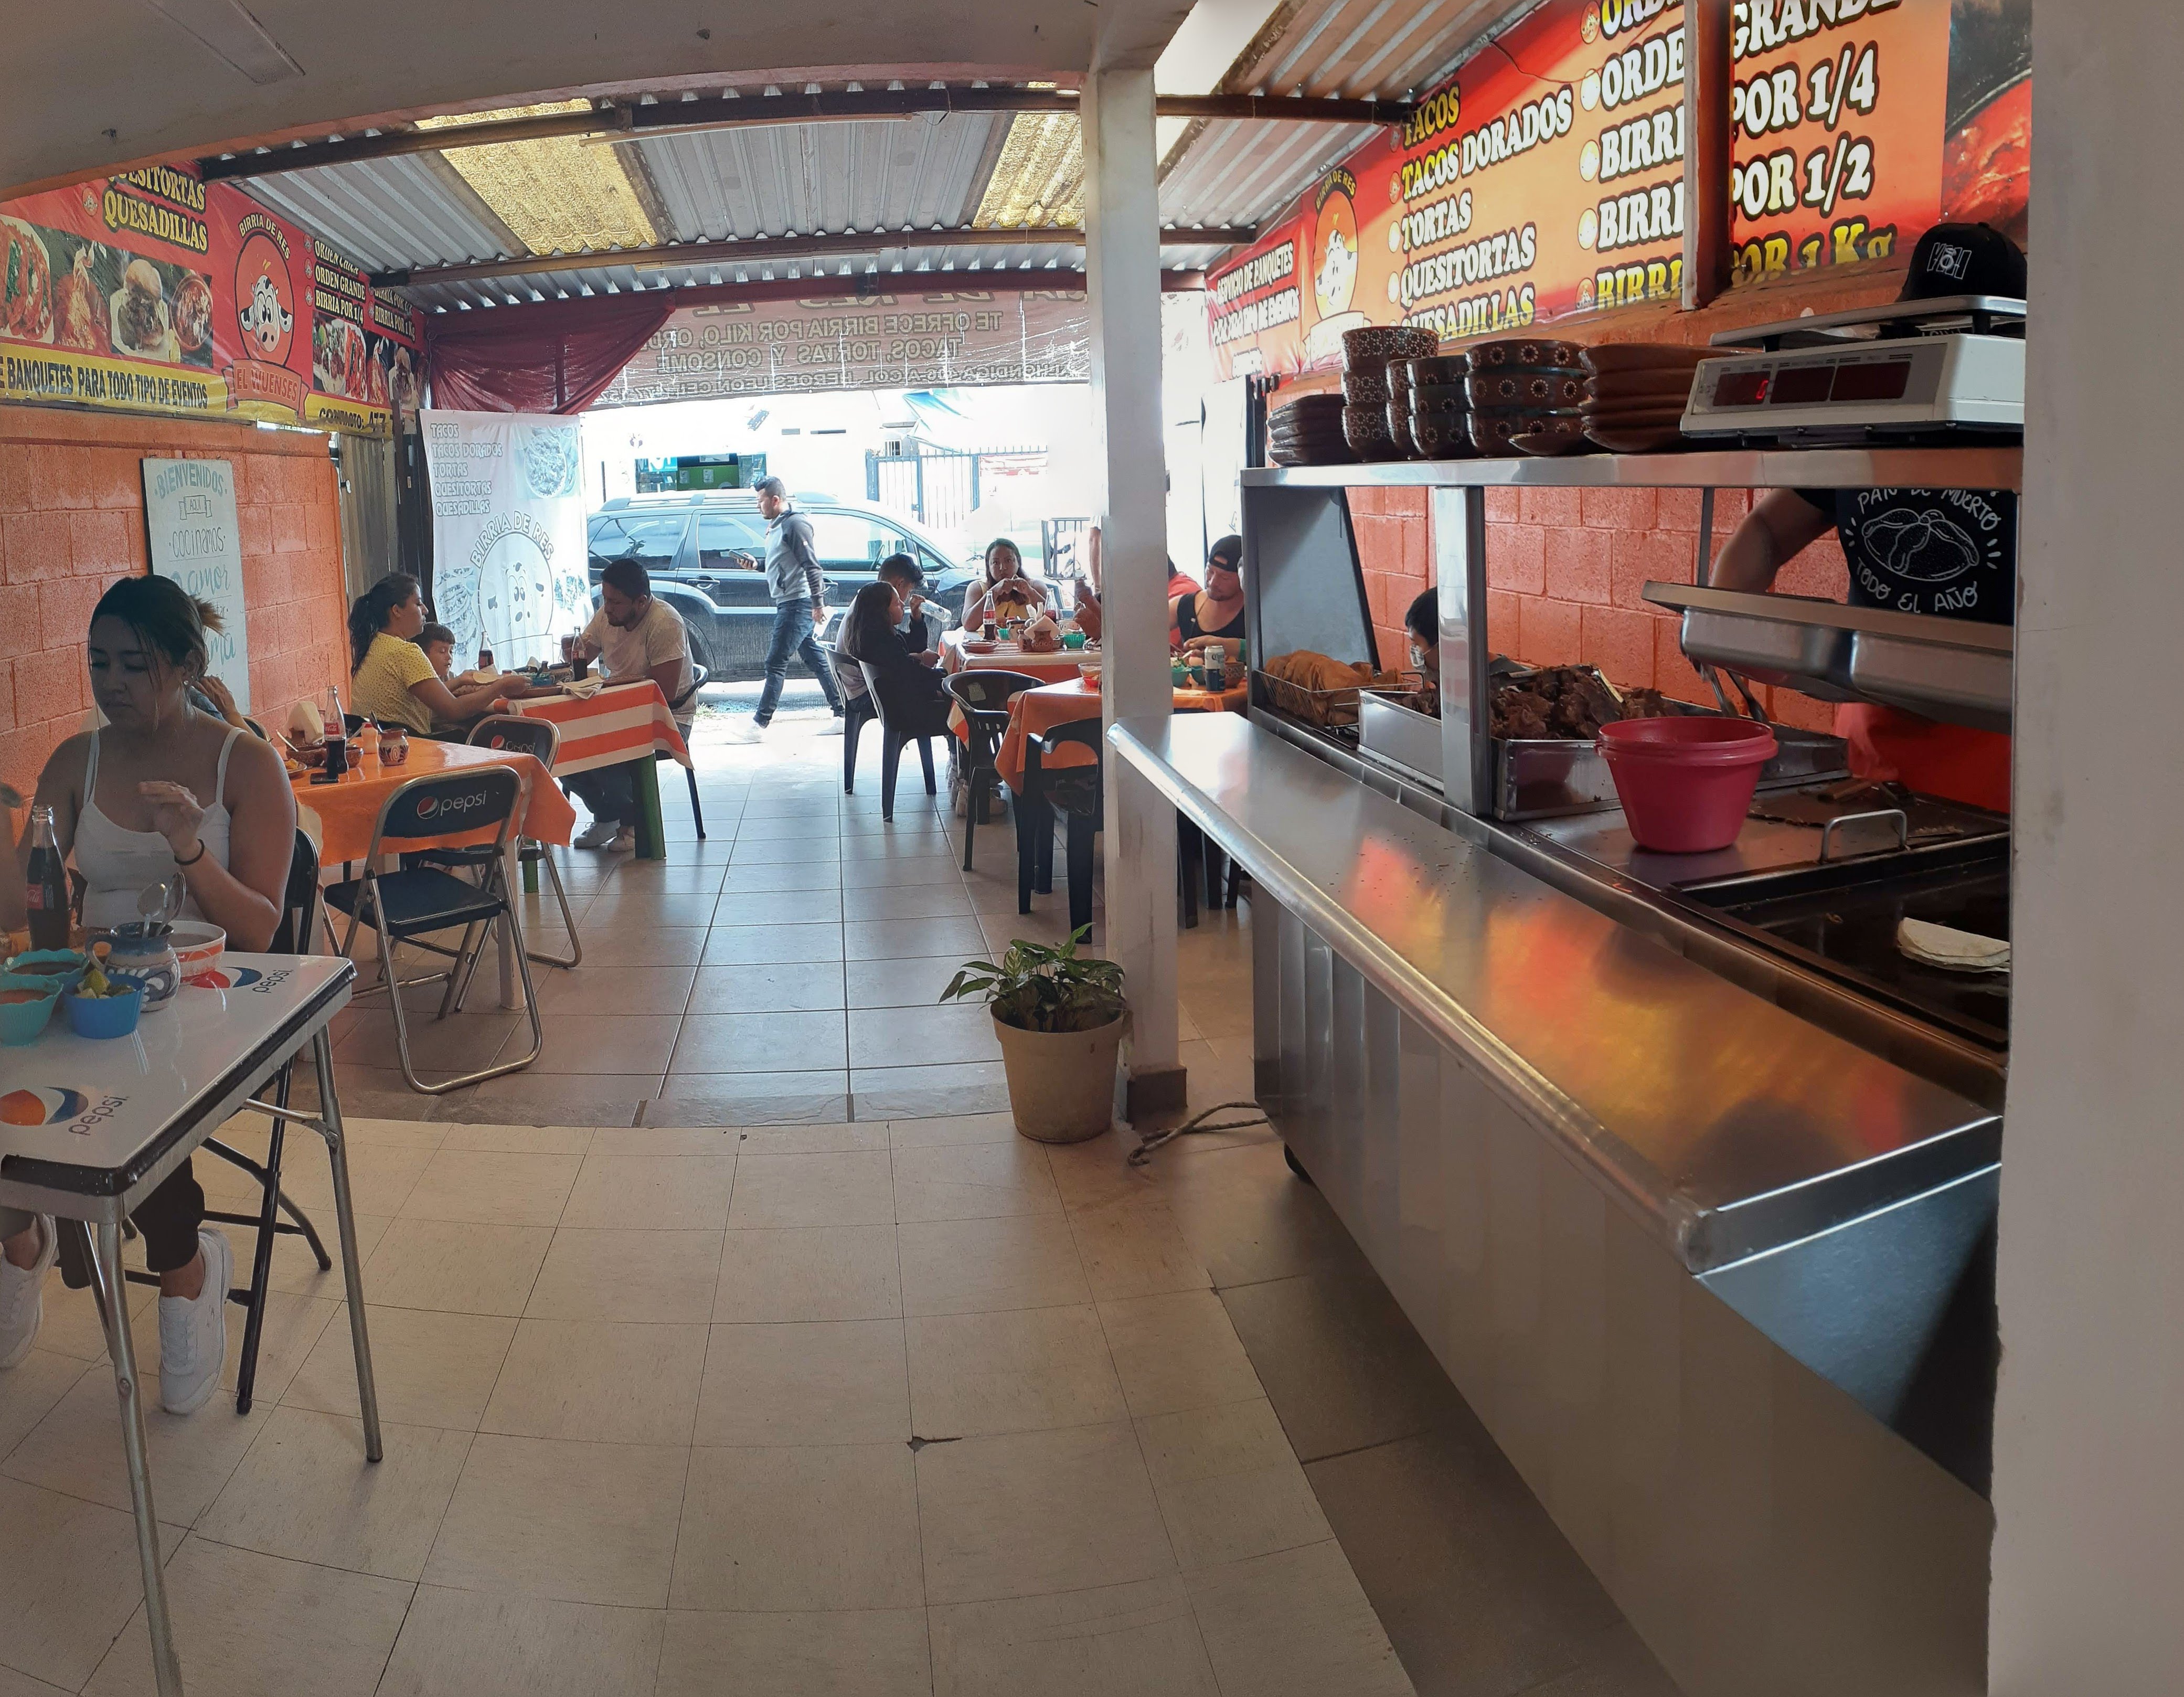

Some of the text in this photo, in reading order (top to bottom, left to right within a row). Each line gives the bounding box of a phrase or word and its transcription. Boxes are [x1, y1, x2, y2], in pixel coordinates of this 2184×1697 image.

[1602, 26, 1685, 107] ORDE
[1600, 105, 1685, 178] BIRRI
[1808, 49, 1874, 125] 1/4
[1402, 89, 1572, 199] TACOS DORADOS
[1316, 169, 1356, 210] BIRRIA DE RES
[1598, 182, 1684, 248] BIRRI
[1805, 138, 1870, 212] 1/2
[105, 189, 207, 251] QUESADILLAS
[238, 213, 291, 260] BIRRIA DE RES
[1401, 192, 1472, 250] TORTAS
[315, 265, 366, 301] ORDEN GRANDE
[1243, 262, 1254, 292] DE
[1401, 226, 1536, 306] QUESITORTAS
[1596, 259, 1683, 311] BIRRI
[316, 290, 364, 325] BIRRIA POR 1/4
[375, 305, 394, 328] BIRRIA
[394, 314, 405, 333] POR
[7, 356, 74, 398] BANQUETES
[77, 366, 106, 398] PARA
[107, 370, 134, 401] TODO
[135, 373, 157, 404] TIPO
[158, 376, 170, 405] DE
[171, 379, 208, 409] EVENTOS
[236, 368, 297, 402] EL WUENSES
[430, 423, 460, 439] TACOS
[431, 442, 503, 459] TACOS DORADOS
[433, 462, 468, 479] TORTAS
[434, 481, 492, 497] QUESITORTAS
[436, 499, 491, 517] QUESADILLAS
[1857, 489, 1898, 515] PAN
[470, 510, 554, 569] BIRRIA DE RES
[1857, 556, 1892, 600] TODO
[1934, 580, 1978, 612] AÑO
[440, 790, 488, 814] pepsi
[252, 969, 292, 994] pepsi
[68, 1095, 128, 1136] pepsi
